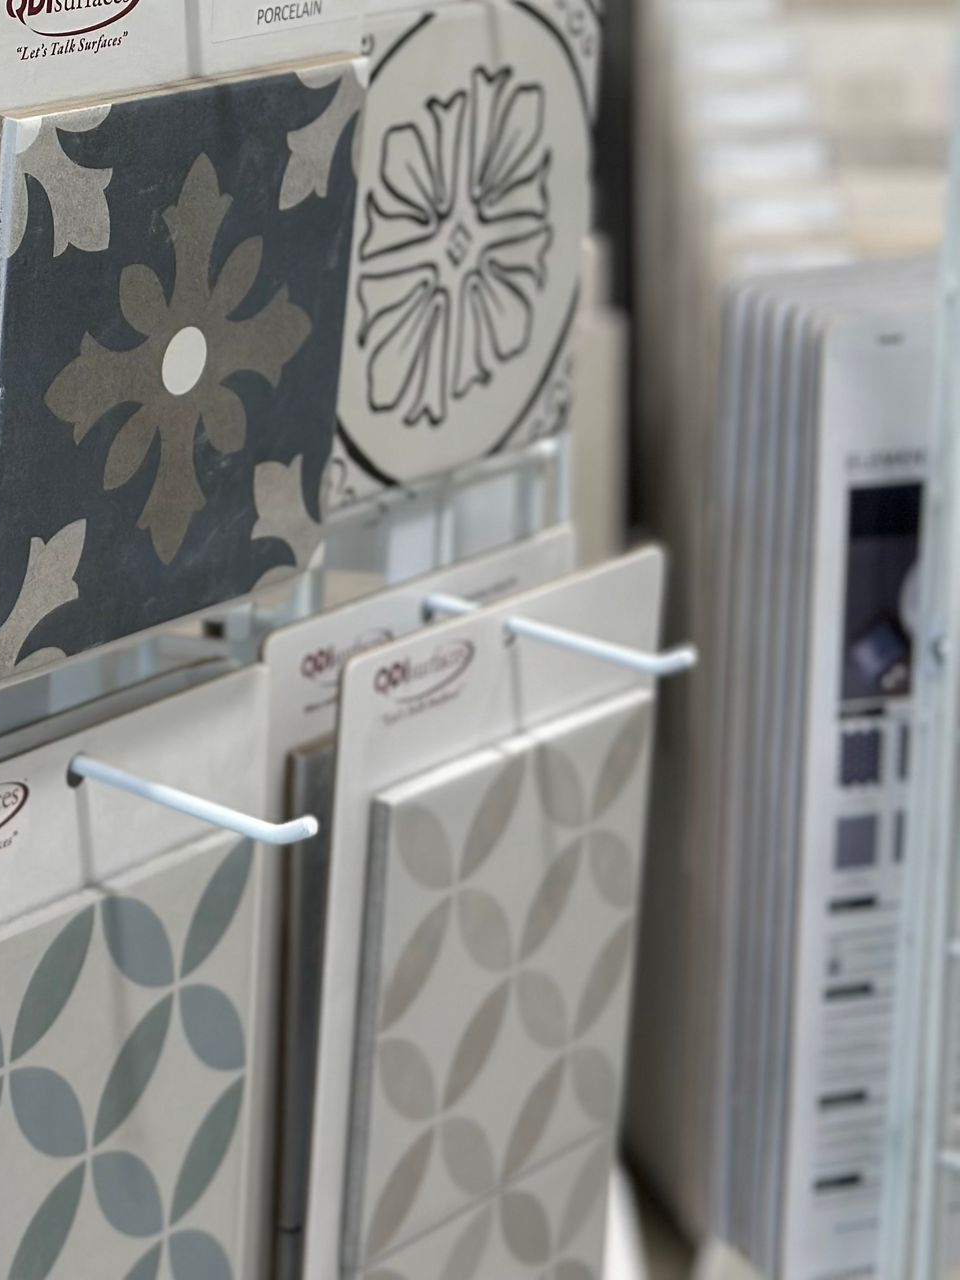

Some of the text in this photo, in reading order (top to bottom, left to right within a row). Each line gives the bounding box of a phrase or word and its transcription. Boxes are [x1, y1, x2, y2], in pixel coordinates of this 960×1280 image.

[257, 0, 323, 25] PORCELAIN
[16, 30, 129, 61] "Let's Talk Surfaces"
